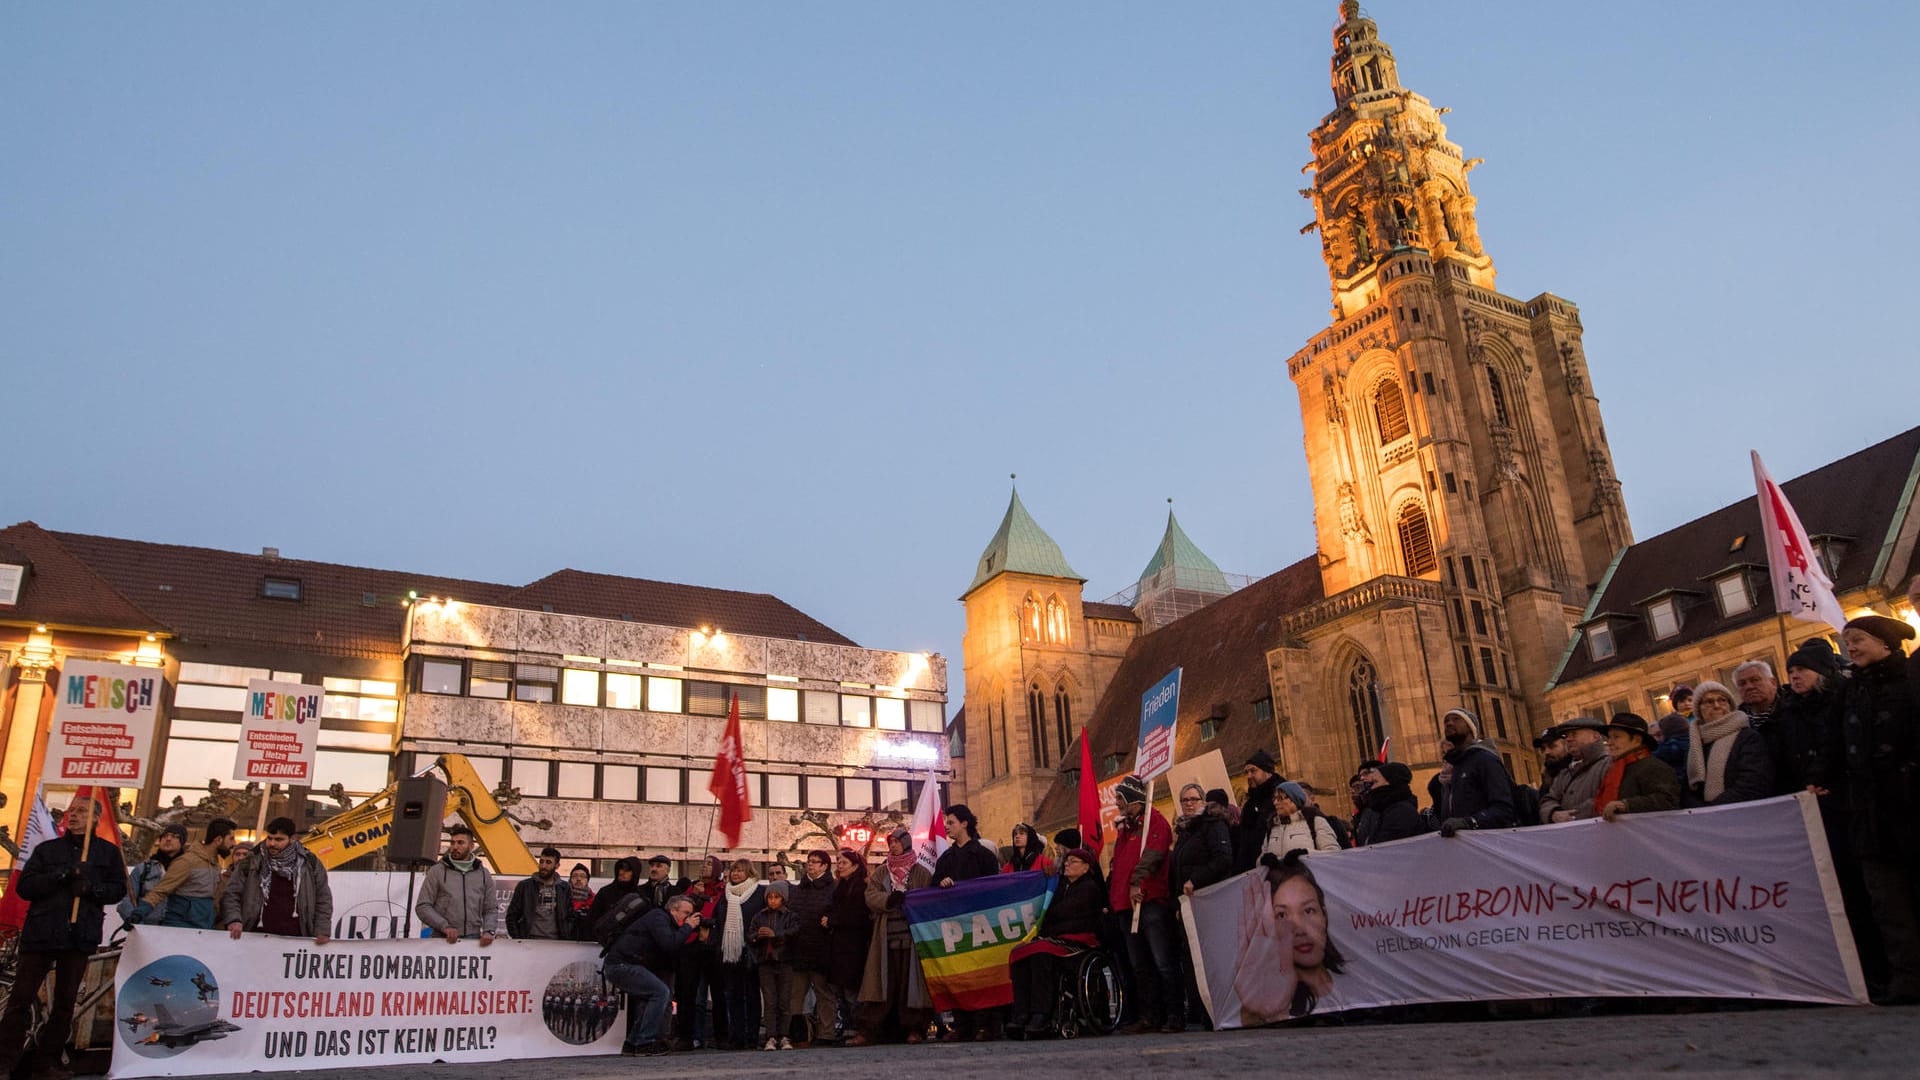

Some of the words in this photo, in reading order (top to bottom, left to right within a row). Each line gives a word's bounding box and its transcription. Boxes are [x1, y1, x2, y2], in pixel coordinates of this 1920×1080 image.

[67, 675, 154, 713] MENSCH
[251, 692, 318, 724] MENSCH
[1144, 682, 1175, 721] Frieden
[63, 723, 124, 735] Entschieden
[249, 732, 295, 741] Entschieden
[85, 747, 113, 756] Hetze
[253, 741, 276, 749] gegen
[276, 743, 301, 752] rechte
[264, 751, 287, 760] Hetze
[66, 761, 90, 775] DIE
[251, 763, 269, 773] DIE
[342, 821, 392, 850] KOMA
[1375, 933, 1461, 954] HEILBRONN
[1466, 926, 1529, 947] GEGEN
[283, 949, 353, 980] TÜRKEI
[360, 955, 493, 981] BOMBARDIERT,
[232, 990, 374, 1019] DEUTSCHLAND
[380, 989, 532, 1018] KRIMINALISIERT:
[264, 1030, 307, 1059] UND
[314, 1029, 351, 1057] DAS
[357, 1029, 390, 1055] IST
[394, 1027, 437, 1054] KEIN
[444, 1025, 497, 1052] DEAL?
